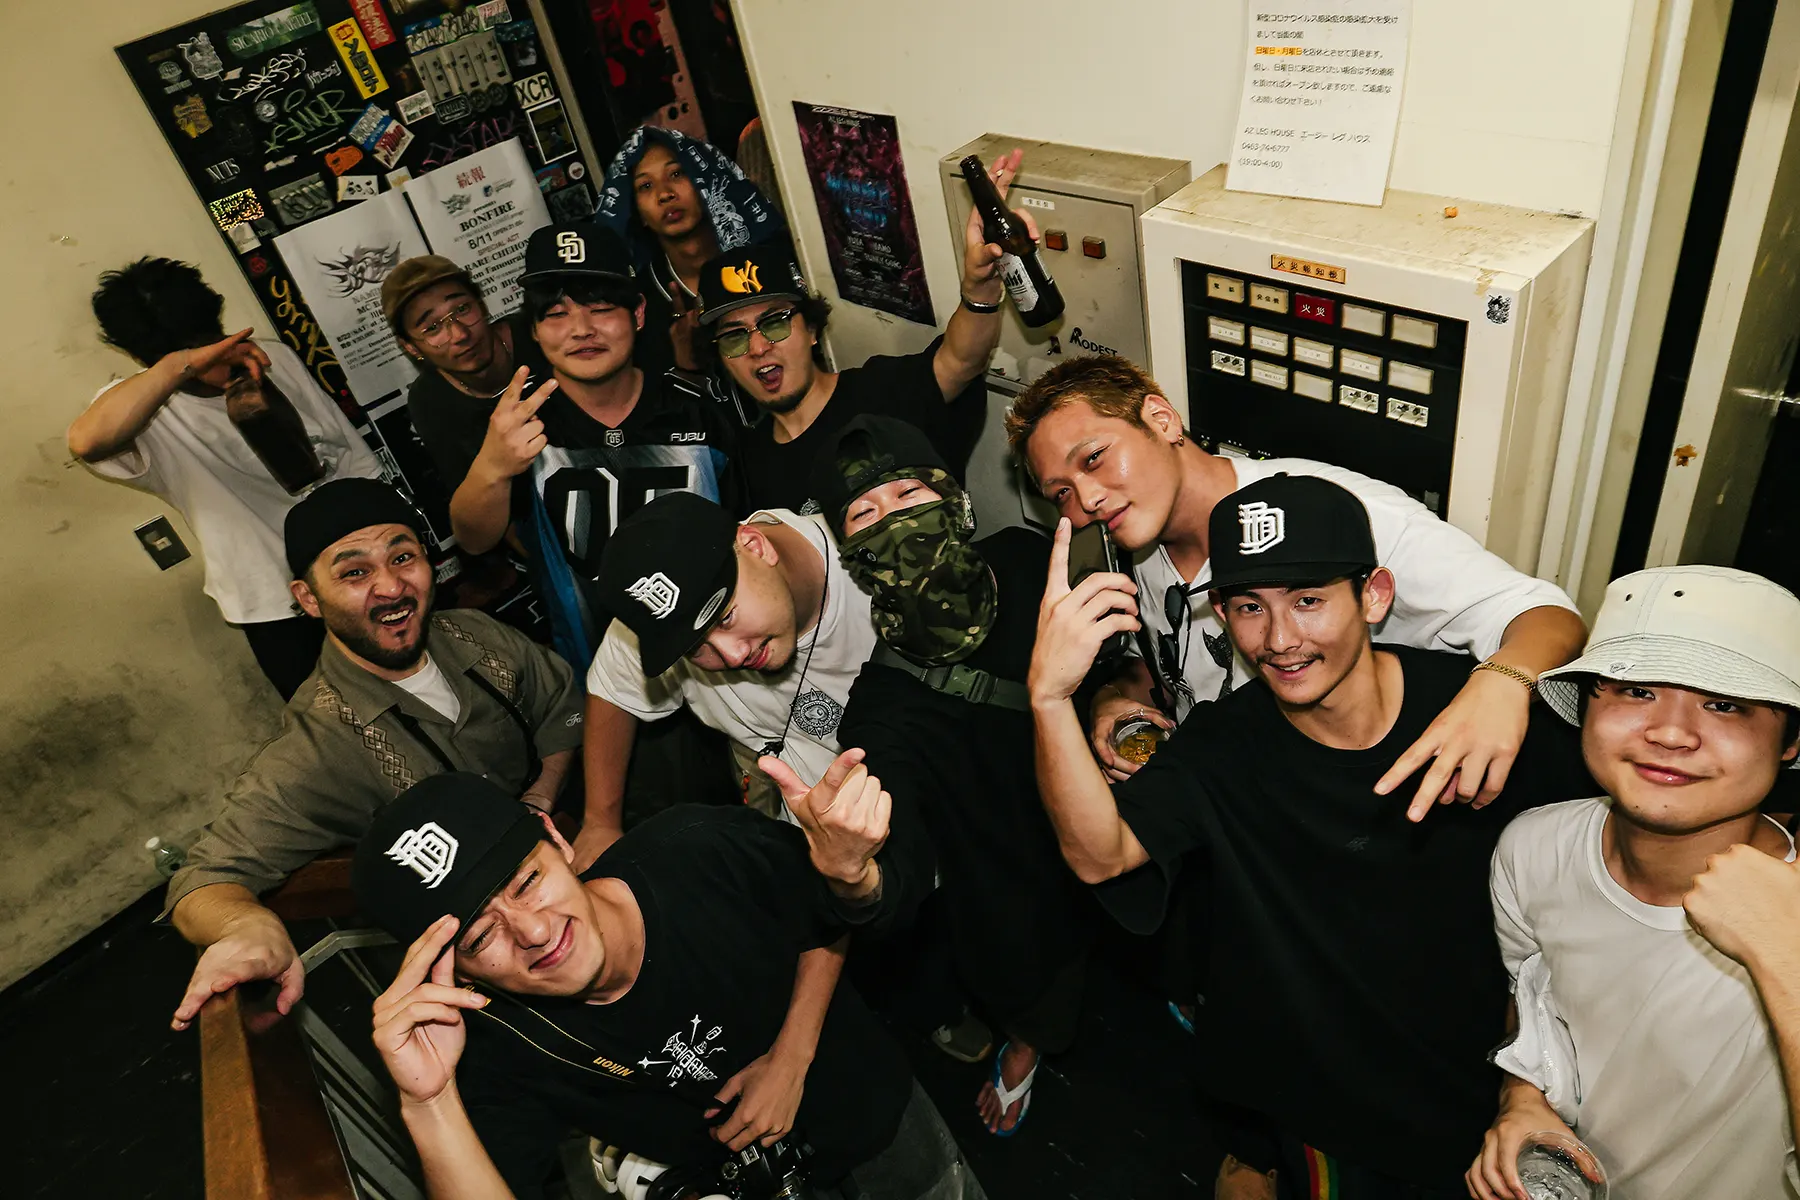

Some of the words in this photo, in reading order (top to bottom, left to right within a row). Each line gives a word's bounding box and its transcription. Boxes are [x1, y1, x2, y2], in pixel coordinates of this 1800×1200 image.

[514, 76, 554, 107] XCR
[205, 157, 241, 183] NUTS
[459, 200, 516, 232] BONFIRE
[468, 232, 493, 250] 8/11
[1301, 303, 1326, 317] 火災
[670, 432, 706, 442] FUBU
[592, 1056, 635, 1078] Nikon
